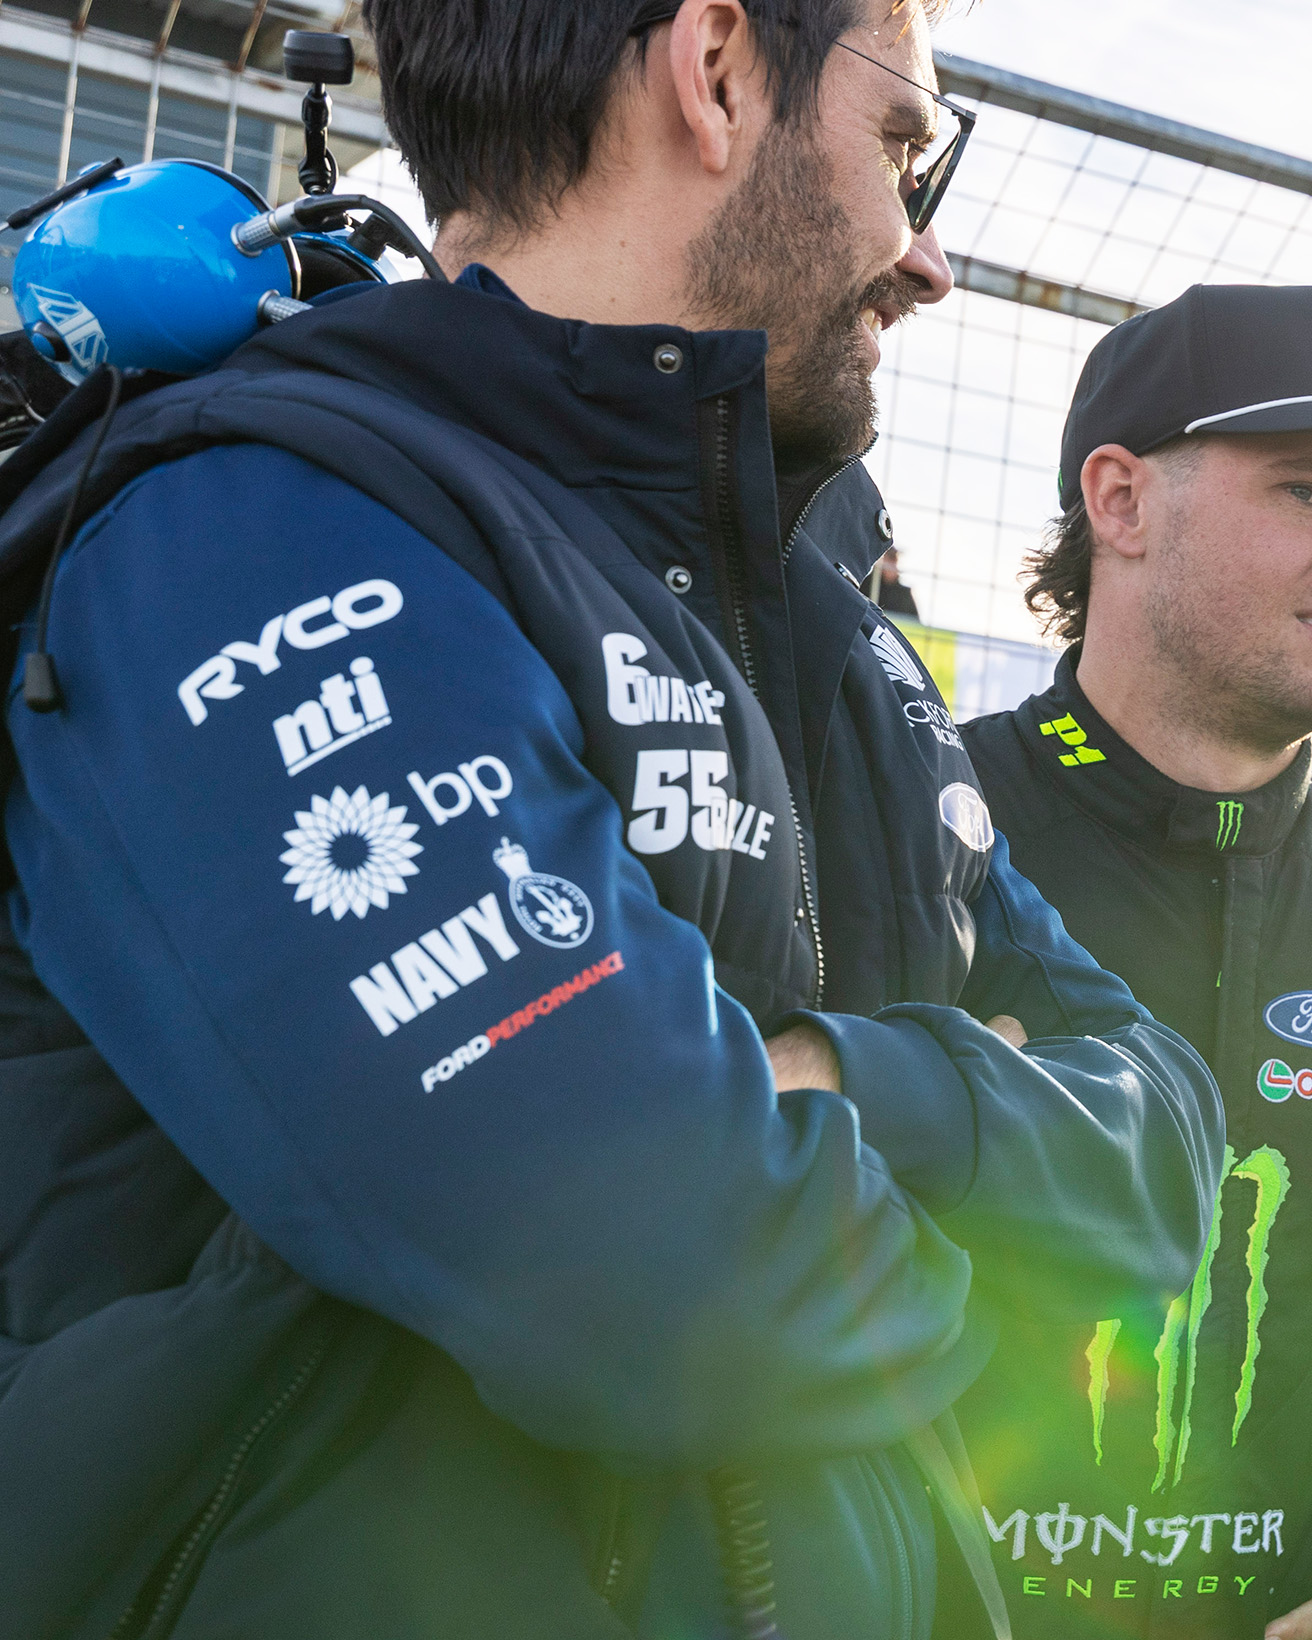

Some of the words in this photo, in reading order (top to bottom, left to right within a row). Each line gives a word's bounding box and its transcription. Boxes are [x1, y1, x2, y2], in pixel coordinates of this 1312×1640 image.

[177, 579, 403, 726] RYCO
[602, 633, 650, 726] 6
[273, 656, 391, 768] nti
[407, 753, 513, 827] bp
[627, 749, 729, 855] 55
[350, 892, 521, 1037] NAVY
[1022, 1575, 1257, 1600] ENERGY
